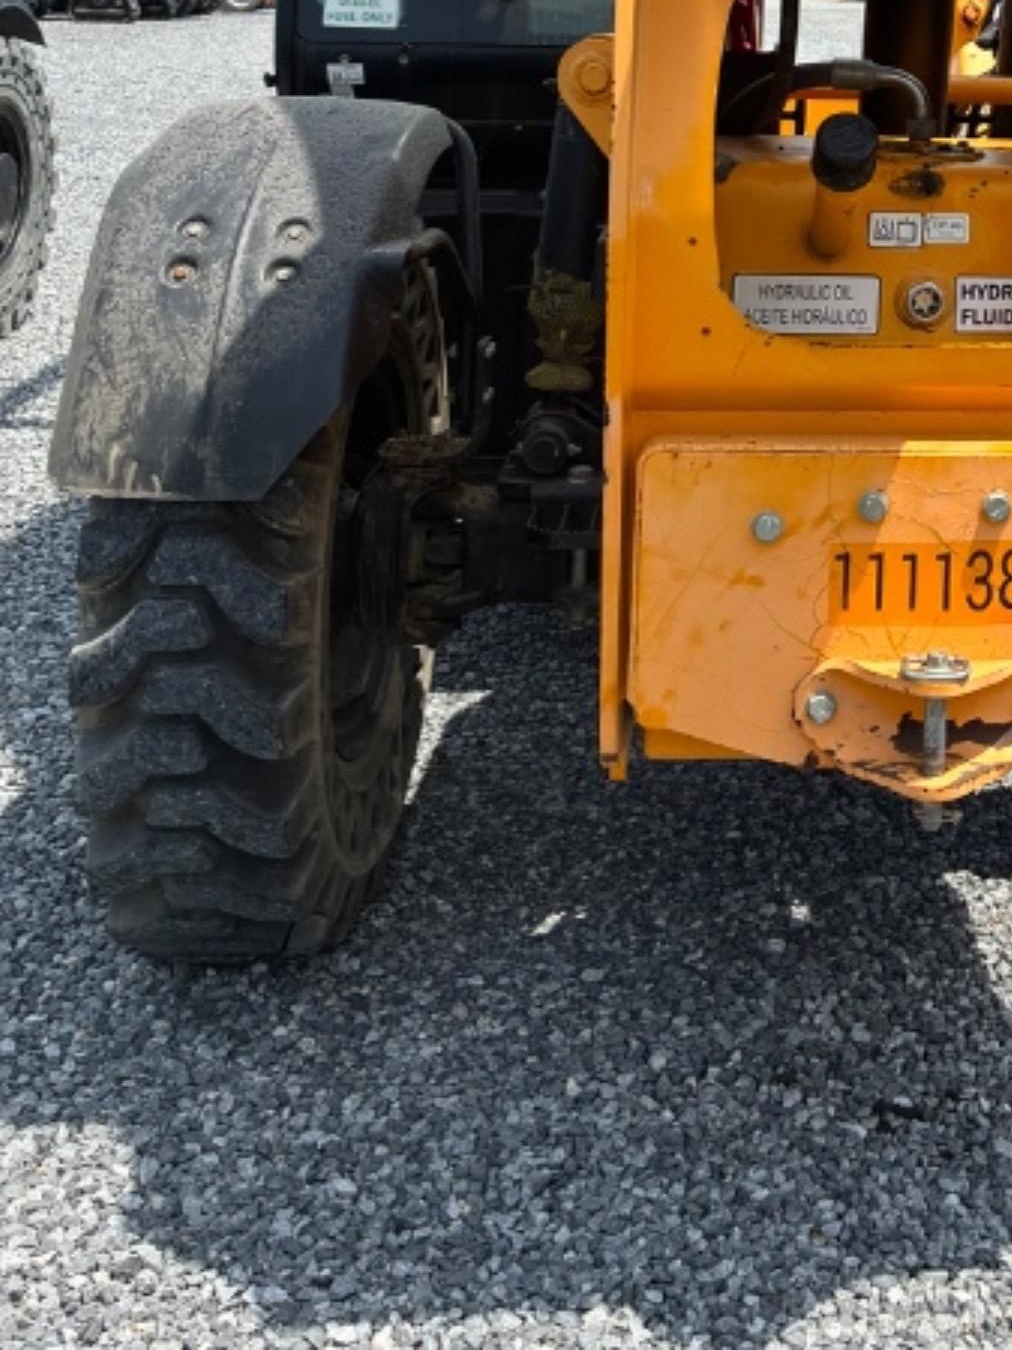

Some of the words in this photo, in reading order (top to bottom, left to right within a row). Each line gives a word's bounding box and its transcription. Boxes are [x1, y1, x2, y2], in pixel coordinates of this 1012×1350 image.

[758, 284, 831, 300] HYDRAULIC
[834, 285, 853, 300] OIL
[792, 306, 867, 325] HIDRÁULICO
